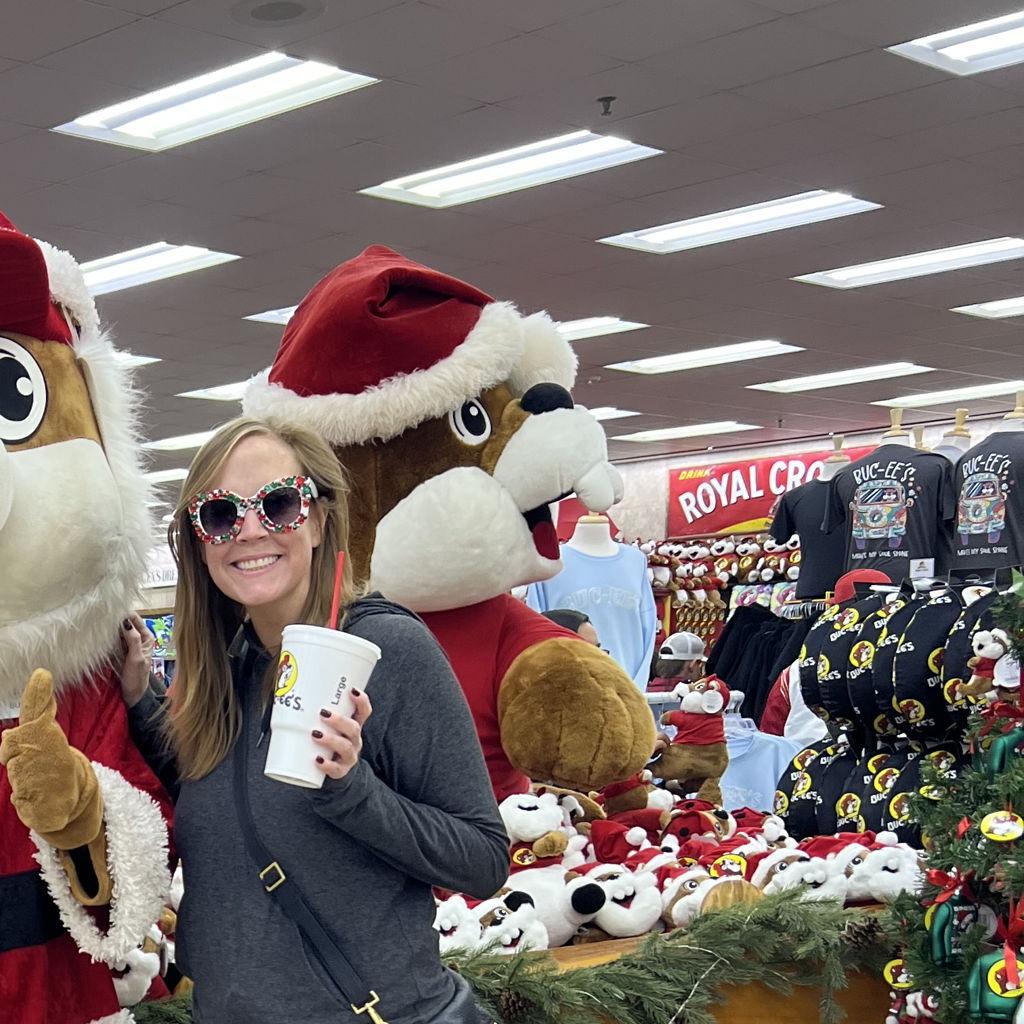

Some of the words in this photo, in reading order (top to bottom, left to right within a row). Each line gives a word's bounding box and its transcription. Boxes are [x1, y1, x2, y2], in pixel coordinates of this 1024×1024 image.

[853, 461, 916, 484] BUC-EE'S
[678, 465, 764, 524] ROYAL
[769, 460, 824, 495] CRO
[331, 676, 347, 705] Large
